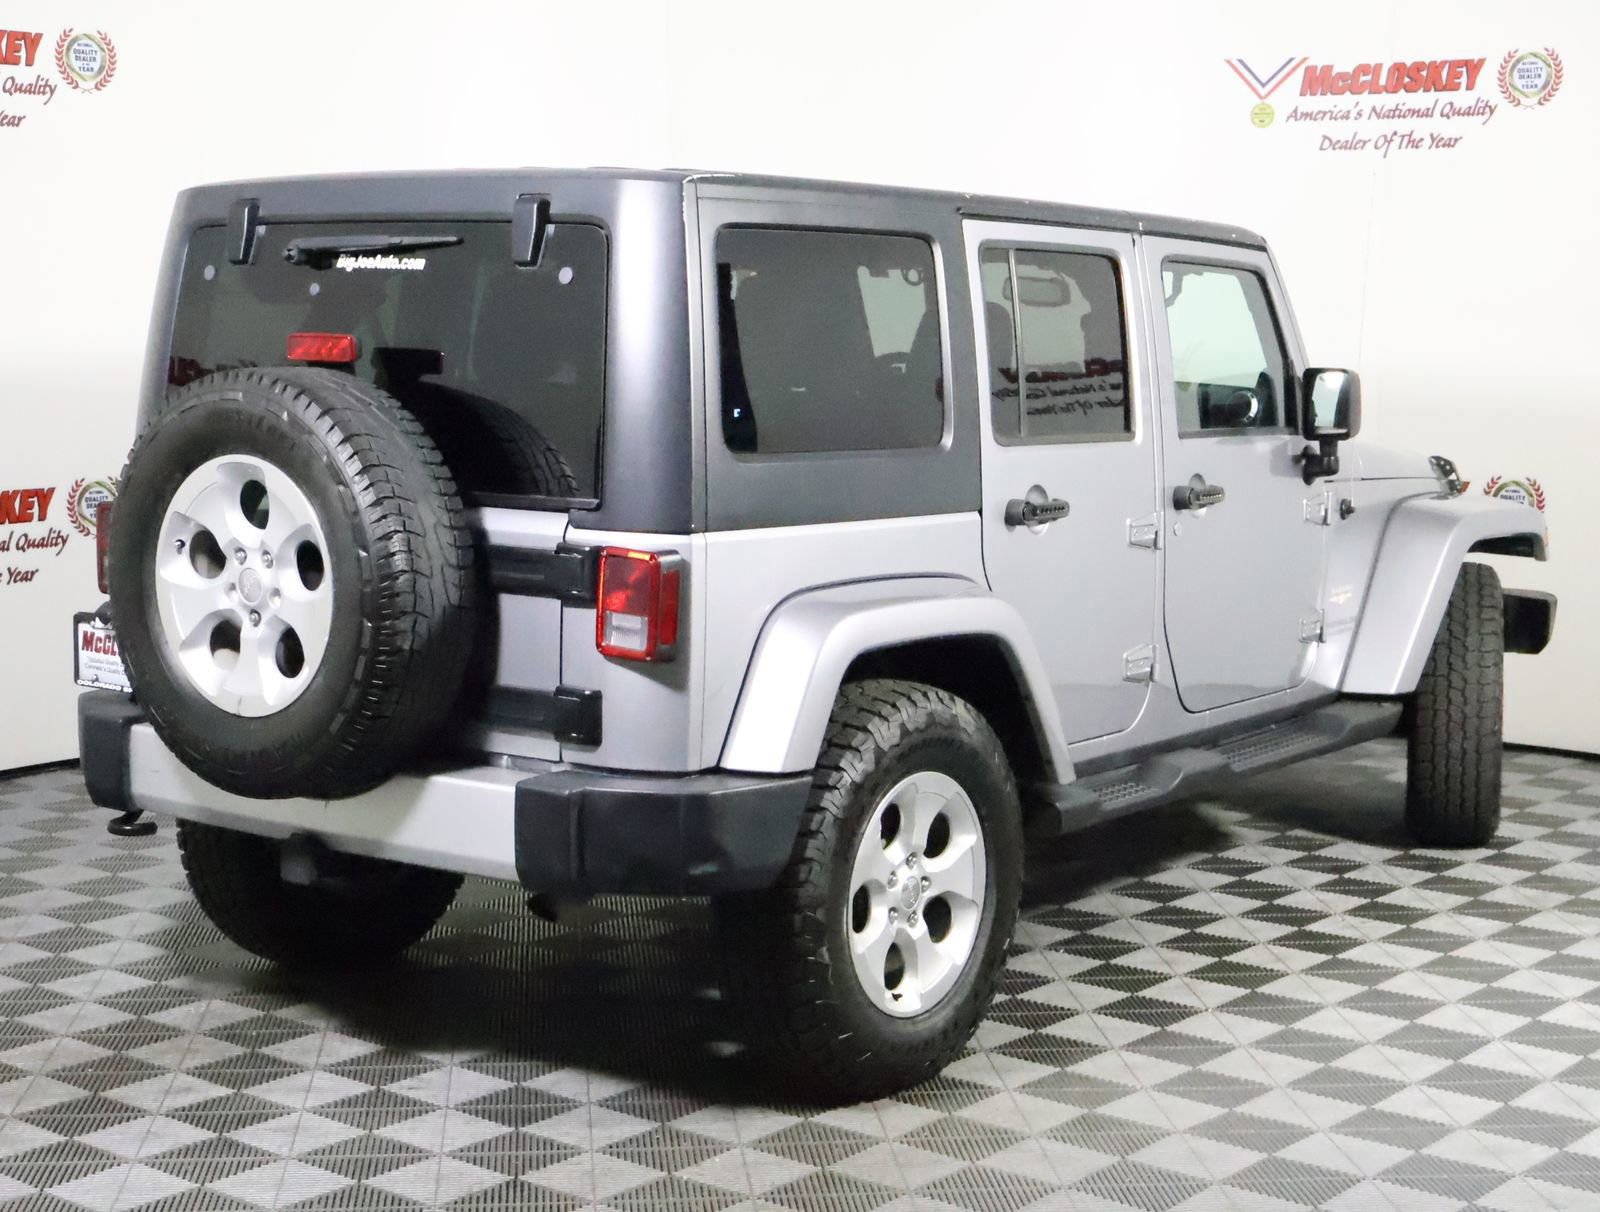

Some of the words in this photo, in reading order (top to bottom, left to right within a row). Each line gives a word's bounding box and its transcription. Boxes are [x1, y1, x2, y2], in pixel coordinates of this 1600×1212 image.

[2, 75, 57, 105] Quality
[1299, 58, 1487, 97] McCLOSKEY
[1285, 101, 1363, 123] America's
[1367, 98, 1439, 120] National
[1440, 97, 1498, 125] Quality
[1319, 131, 1372, 151] Dealer
[1374, 130, 1398, 159] Of
[1398, 130, 1424, 150] The
[1428, 132, 1463, 150] Year
[336, 254, 426, 272] BigJoeAuto.com
[0, 487, 56, 525] KEY
[15, 527, 70, 556] Quality
[6, 566, 39, 586] Year
[77, 679, 121, 692] COLORADO
